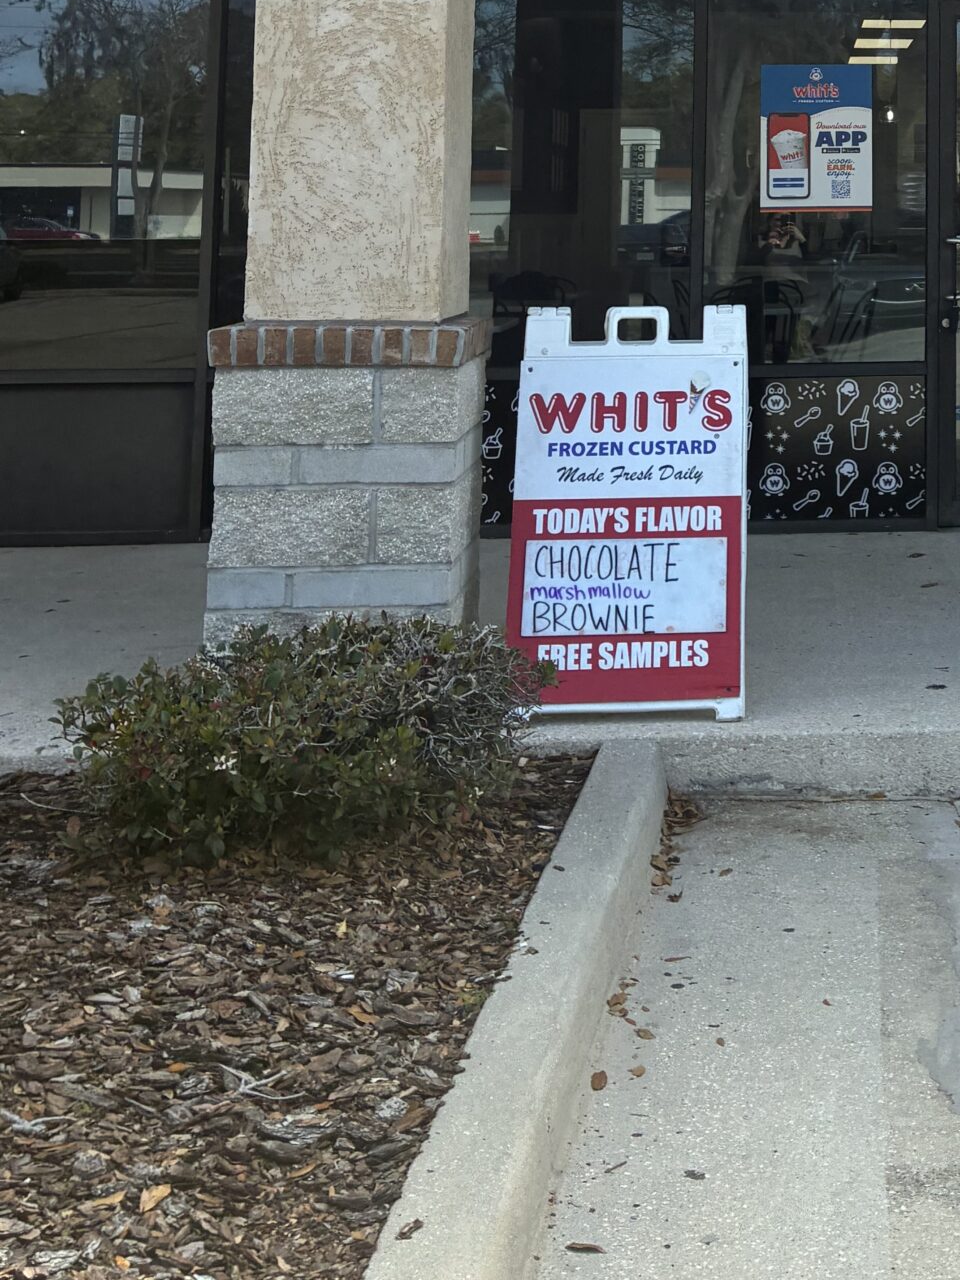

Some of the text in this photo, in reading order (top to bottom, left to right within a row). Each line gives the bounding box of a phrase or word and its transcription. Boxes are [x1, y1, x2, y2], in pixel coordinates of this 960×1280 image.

[815, 121, 852, 130] Download
[814, 130, 868, 148] APP
[529, 371, 733, 435] WHIT'S
[771, 398, 782, 408] W
[883, 397, 893, 407] W
[547, 439, 717, 457] FROZEN CUSTARD
[556, 464, 704, 485] Made Fresh Daily
[770, 479, 781, 488] W
[883, 478, 893, 487] W
[532, 505, 723, 535] TODAY'S FLAVOR
[534, 542, 681, 583] CHOCOLATE
[529, 582, 652, 601] marshmallow
[531, 600, 656, 634] BROWNIE
[537, 639, 710, 671] FREE SAMPLES
